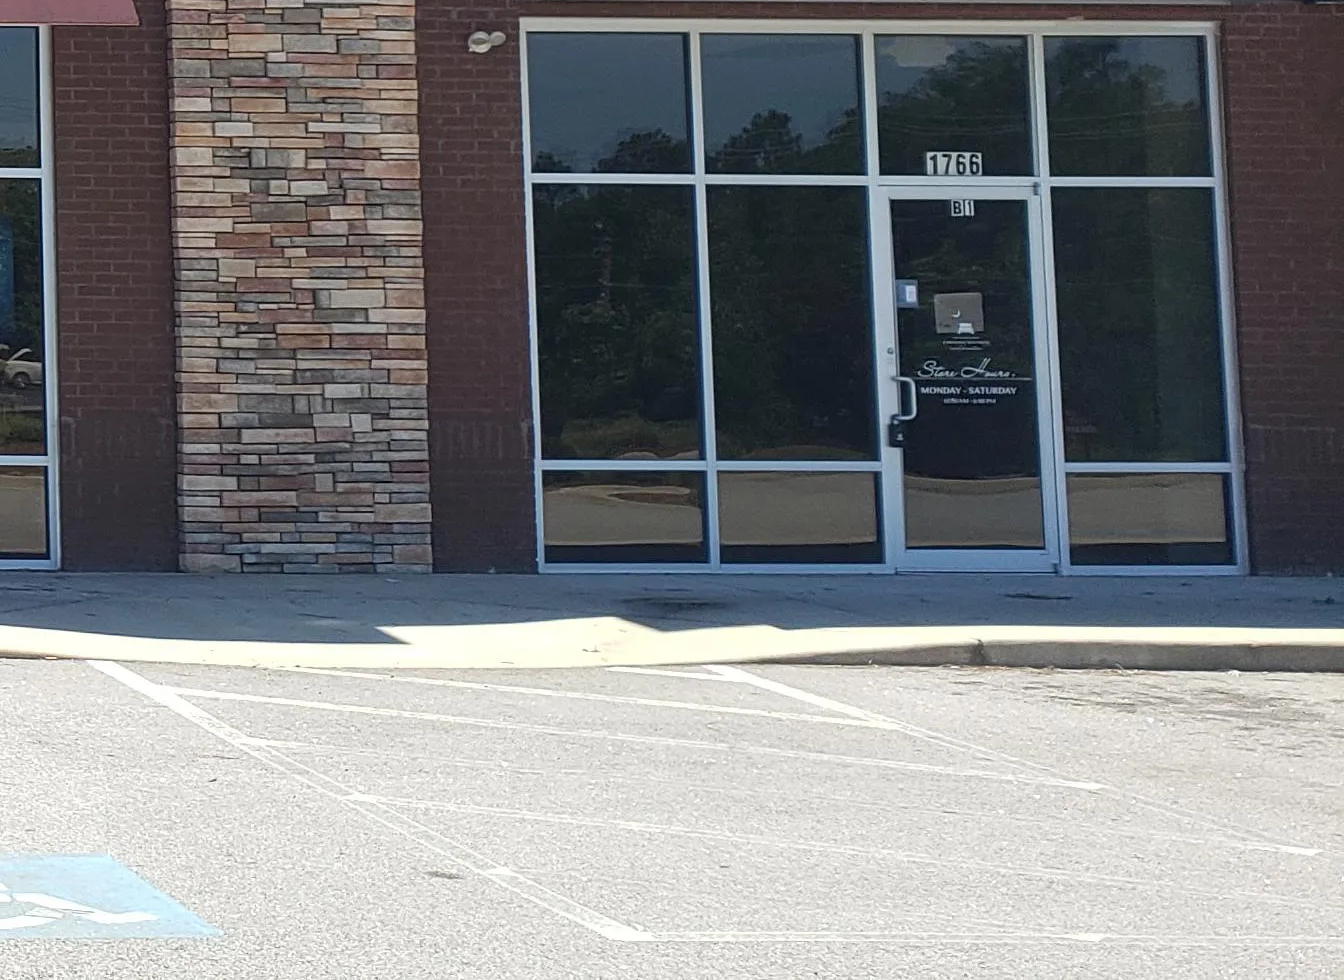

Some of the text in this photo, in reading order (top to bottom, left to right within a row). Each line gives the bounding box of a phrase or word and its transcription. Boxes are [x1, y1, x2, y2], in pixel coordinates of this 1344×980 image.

[928, 153, 981, 175] 1766
[920, 386, 962, 395] MONDAY
[968, 386, 1018, 395] SATURDAY
